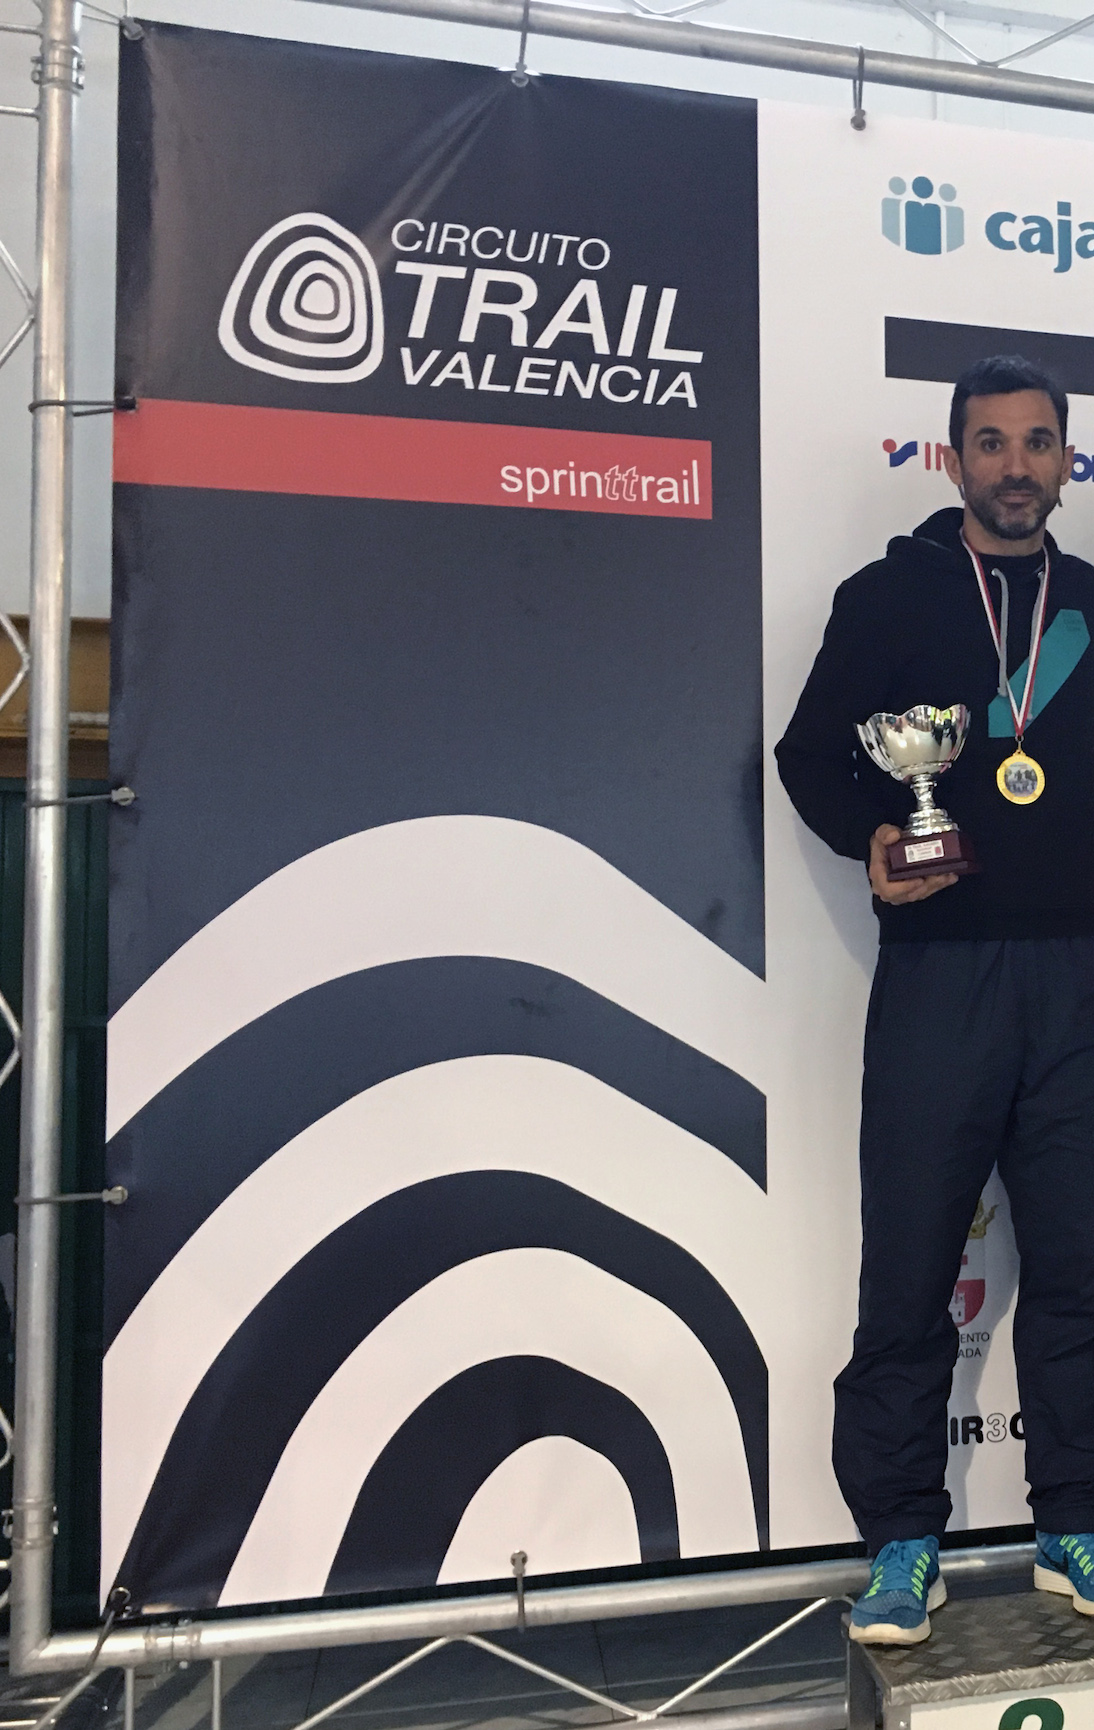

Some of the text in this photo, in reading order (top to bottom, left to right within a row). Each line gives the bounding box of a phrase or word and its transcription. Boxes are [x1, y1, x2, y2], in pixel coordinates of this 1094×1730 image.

[390, 218, 611, 270] CIRCUITO
[395, 260, 704, 364] TRAIL
[400, 346, 698, 408] VALENCIA
[500, 459, 700, 505] sprinttrail
